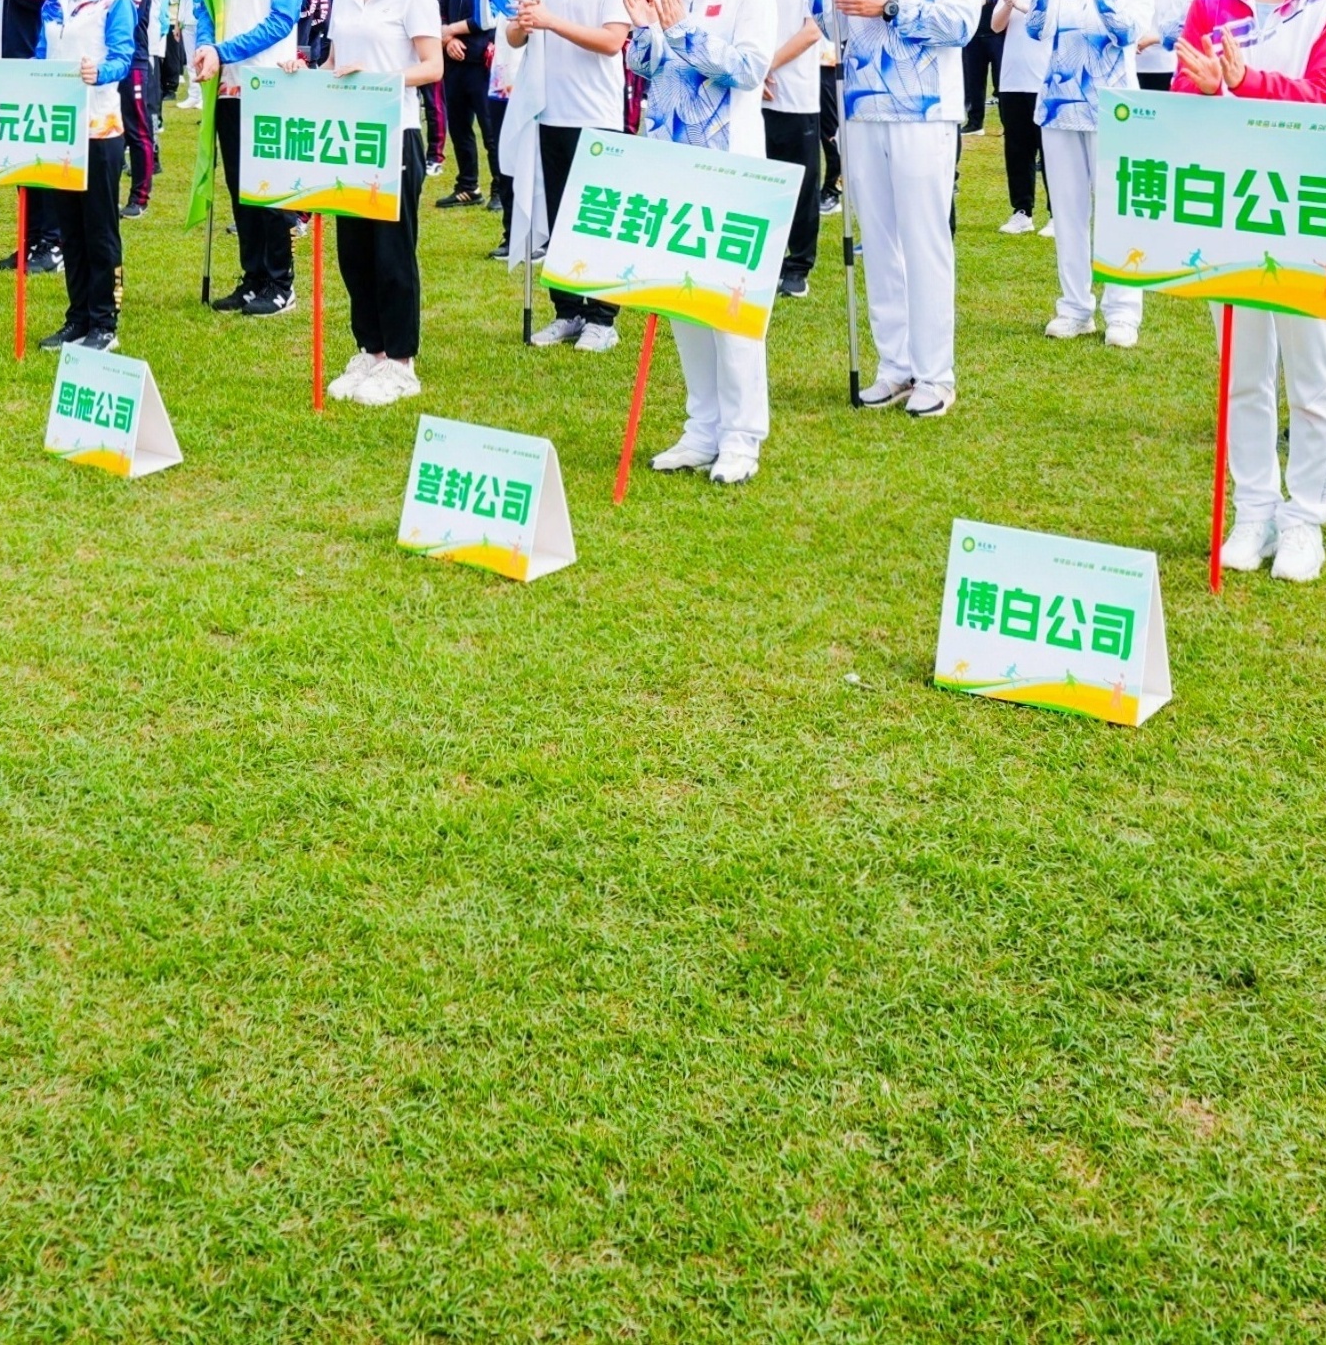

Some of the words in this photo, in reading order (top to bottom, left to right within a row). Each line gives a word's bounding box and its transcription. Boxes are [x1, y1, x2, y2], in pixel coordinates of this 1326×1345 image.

[252, 114, 388, 170] 恩施公司
[571, 184, 771, 273] 登封公司
[56, 380, 136, 434] 恩施公司
[414, 462, 534, 526] 登封公司
[955, 576, 1136, 662] 博白公司
